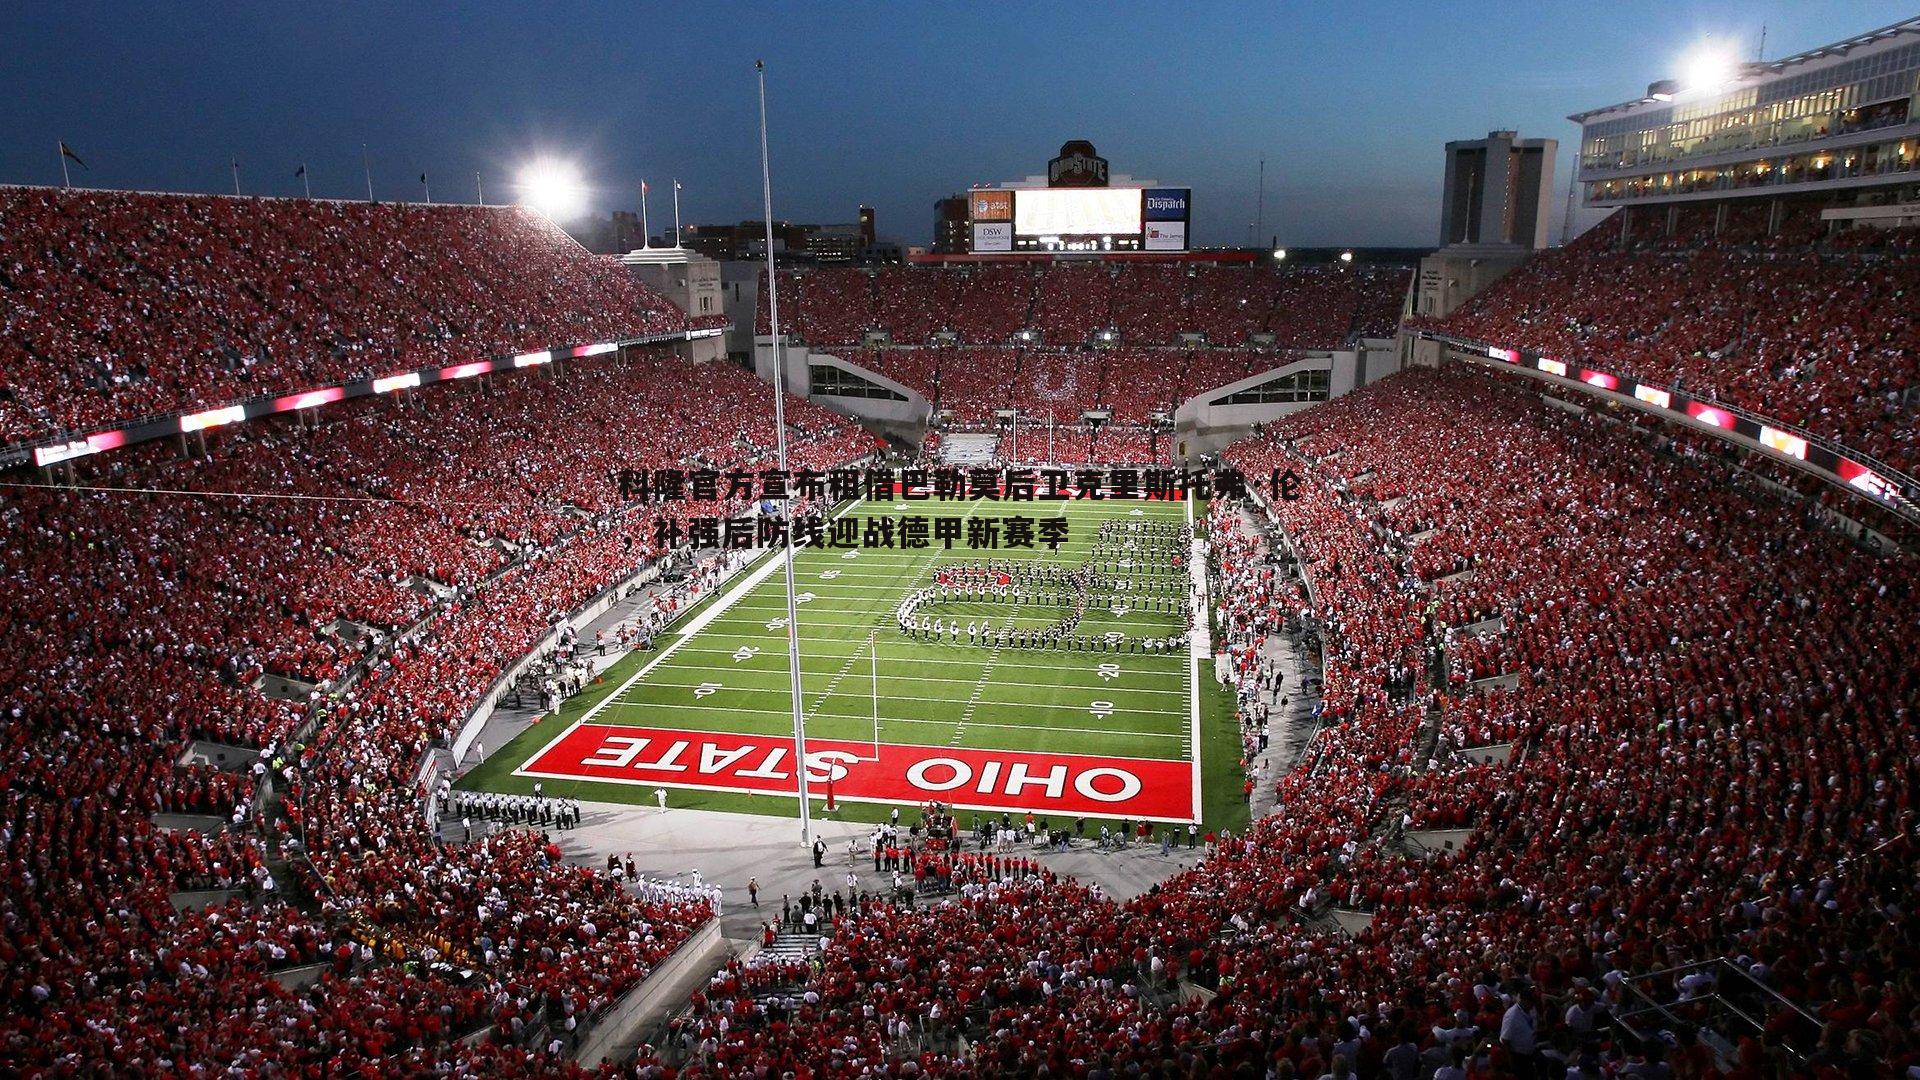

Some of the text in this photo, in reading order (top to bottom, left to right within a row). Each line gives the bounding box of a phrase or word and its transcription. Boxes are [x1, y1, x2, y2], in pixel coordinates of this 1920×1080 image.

[1147, 197, 1185, 211] Dispatch
[983, 228, 1002, 236] DSW
[732, 646, 760, 660] 20
[1097, 663, 1120, 678] 20
[694, 682, 723, 695] 10
[1089, 700, 1114, 715] 10
[580, 735, 1143, 802] OHIO STATE
